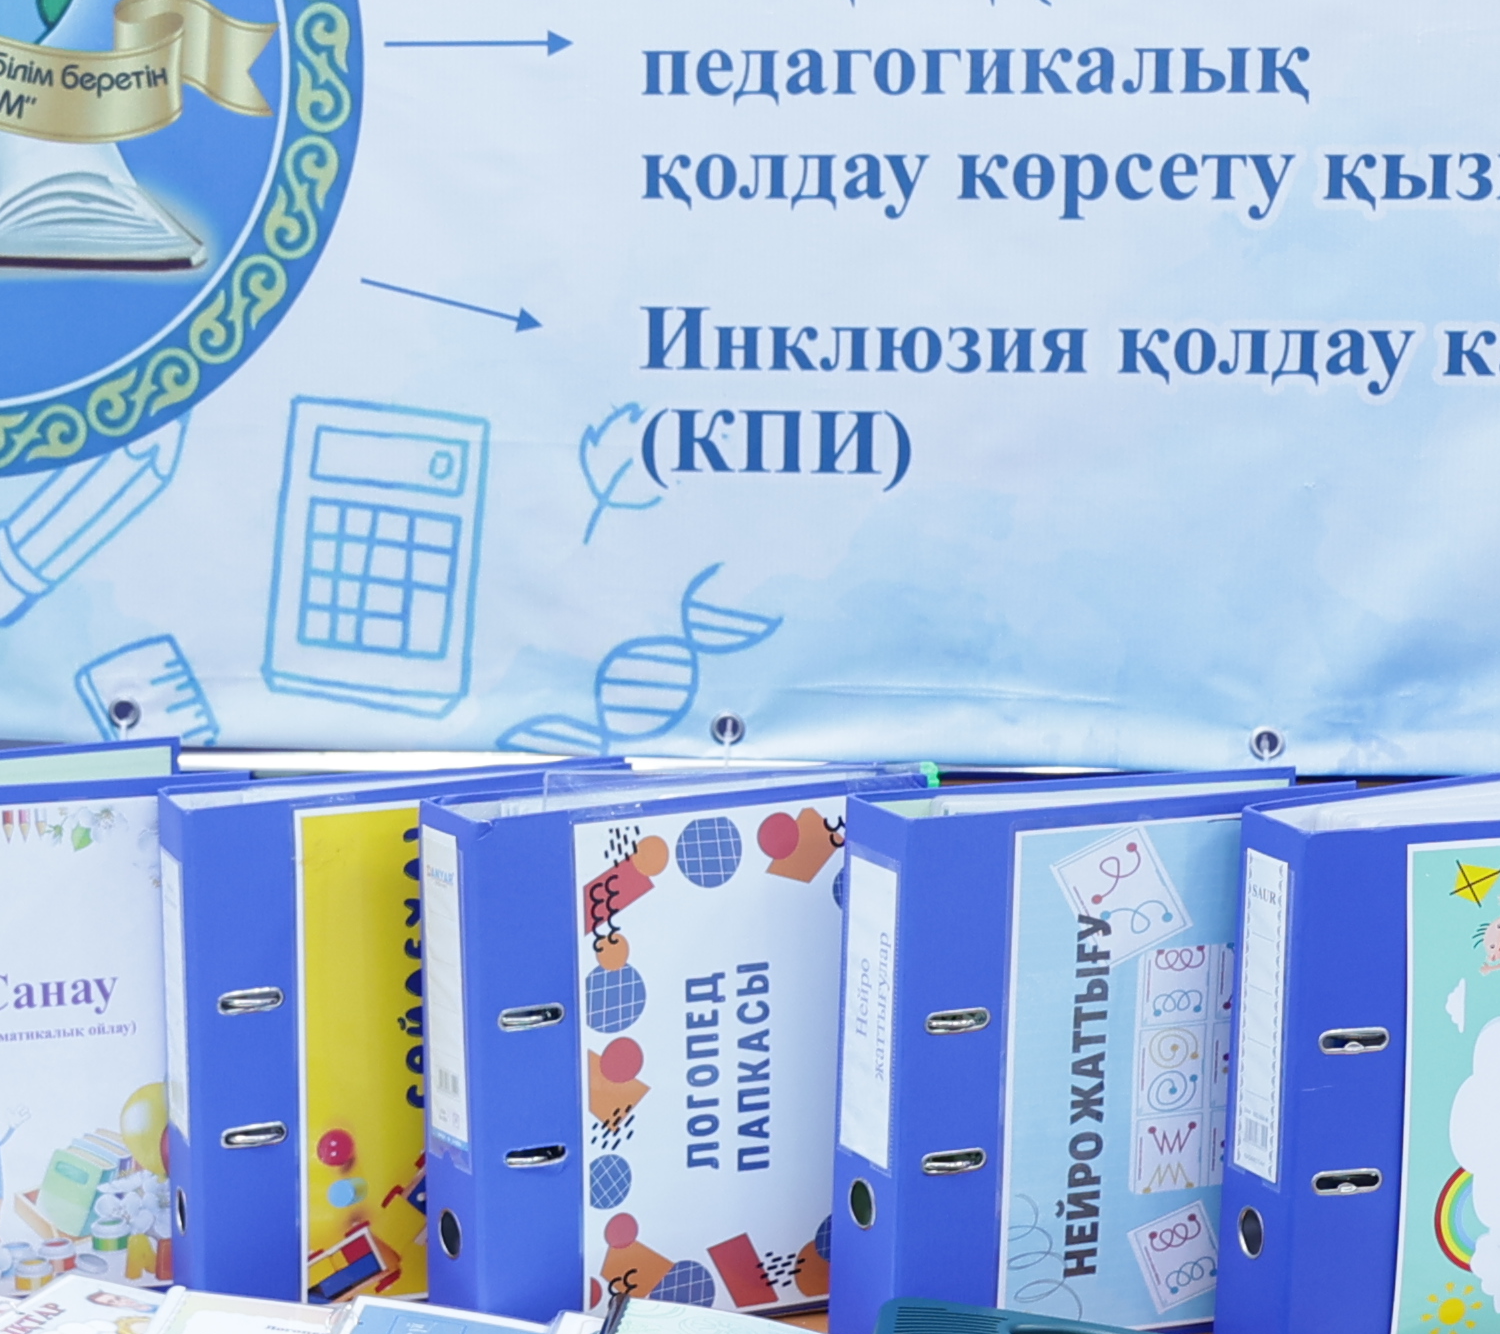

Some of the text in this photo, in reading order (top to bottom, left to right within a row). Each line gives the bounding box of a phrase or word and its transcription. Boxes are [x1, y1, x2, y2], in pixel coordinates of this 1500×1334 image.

[60, 62, 169, 102] беретін
[643, 46, 1310, 104] педагогикалық
[642, 153, 930, 220] қолдау
[958, 153, 1295, 221] көрсету
[643, 306, 1087, 374] Инклюзия
[1119, 328, 1415, 396] қолдау
[641, 409, 912, 491] (КПИ)
[1252, 882, 1277, 906] SAUR
[87, 1019, 138, 1038] ойлау)
[855, 957, 873, 1039] Нейро
[874, 930, 891, 1083] жаттығулар
[684, 969, 728, 1171] ЛОГОПЕД
[736, 959, 771, 1173] ПАПКАСЫ
